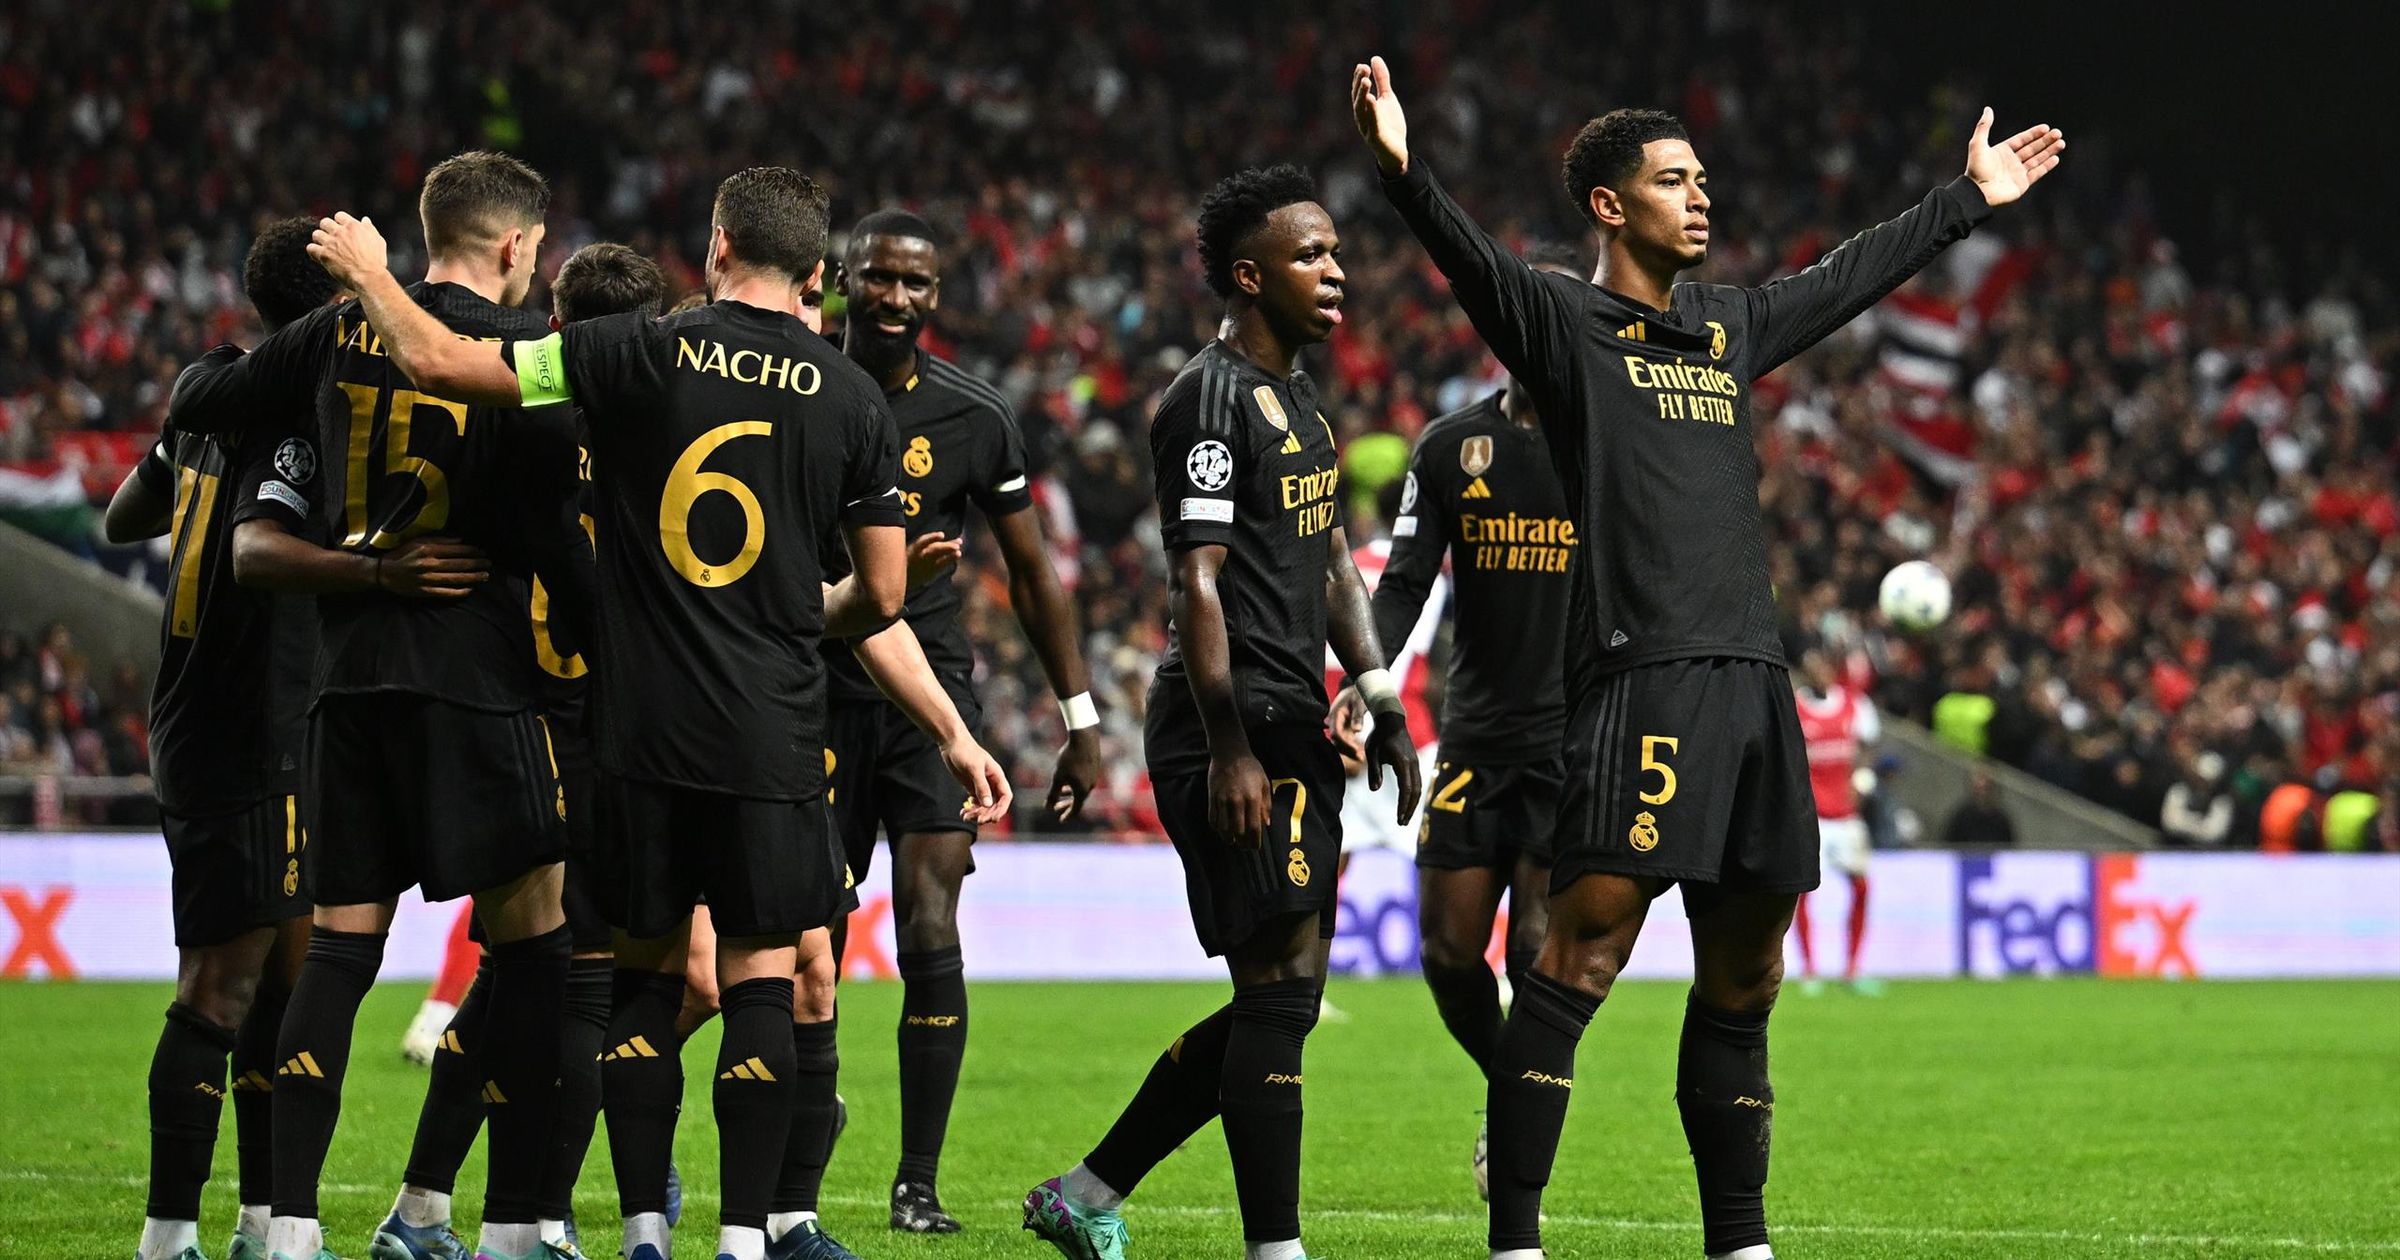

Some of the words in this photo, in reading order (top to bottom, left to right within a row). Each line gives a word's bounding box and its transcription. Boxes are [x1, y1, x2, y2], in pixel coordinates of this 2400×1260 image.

[676, 336, 822, 396] NACHO
[1623, 355, 1738, 397] Emirates
[1657, 393, 1685, 420] FLY
[1688, 395, 1735, 426] BETTER
[337, 382, 467, 550] 15
[1279, 463, 1339, 510] Emira
[659, 420, 773, 588] 6
[1460, 511, 1579, 546] Emirate
[1475, 546, 1504, 570] FLY
[1506, 546, 1569, 573] BETTER
[1639, 735, 1679, 806] 5
[1272, 777, 1307, 843] 7
[1958, 850, 2200, 978] FedEx
